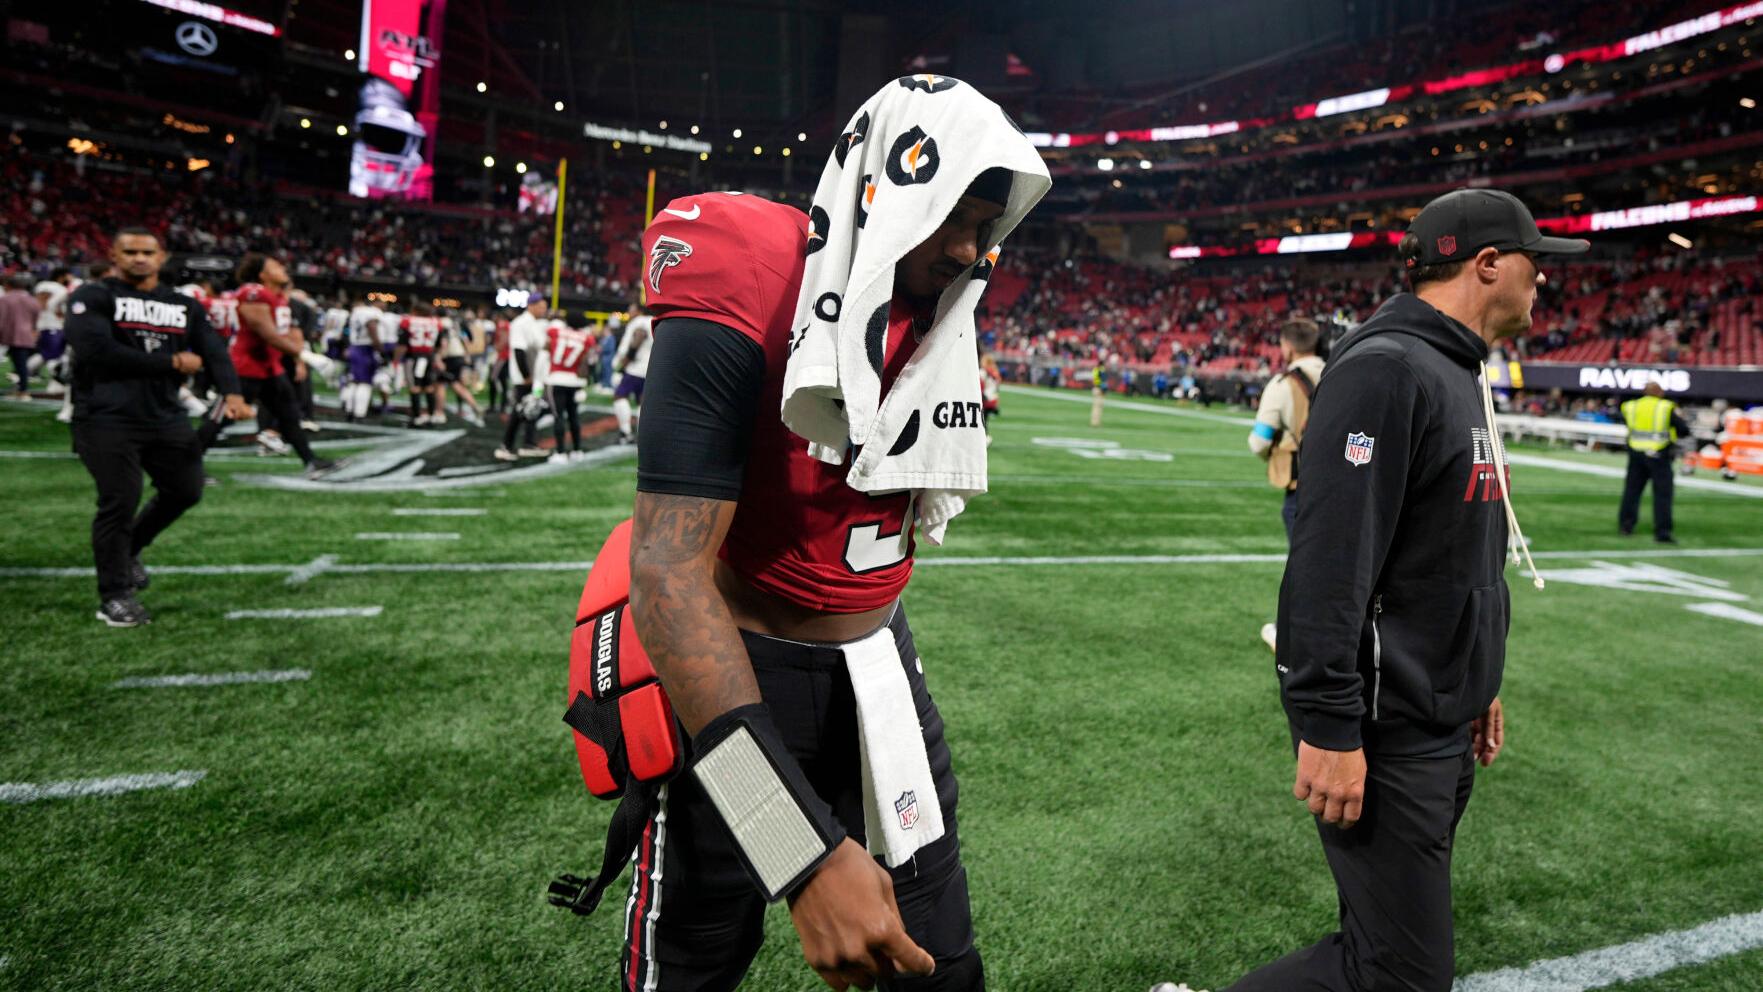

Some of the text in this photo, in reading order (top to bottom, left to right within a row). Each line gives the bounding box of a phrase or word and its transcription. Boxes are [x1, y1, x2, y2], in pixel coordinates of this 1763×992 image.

[114, 297, 188, 328] FALCONS
[408, 325, 439, 348] 33
[552, 338, 586, 368] 17
[1579, 367, 1691, 392] RAVENS
[1349, 445, 1370, 461] NFL
[597, 611, 616, 692] DOUGLAS
[901, 805, 917, 826] NFL
